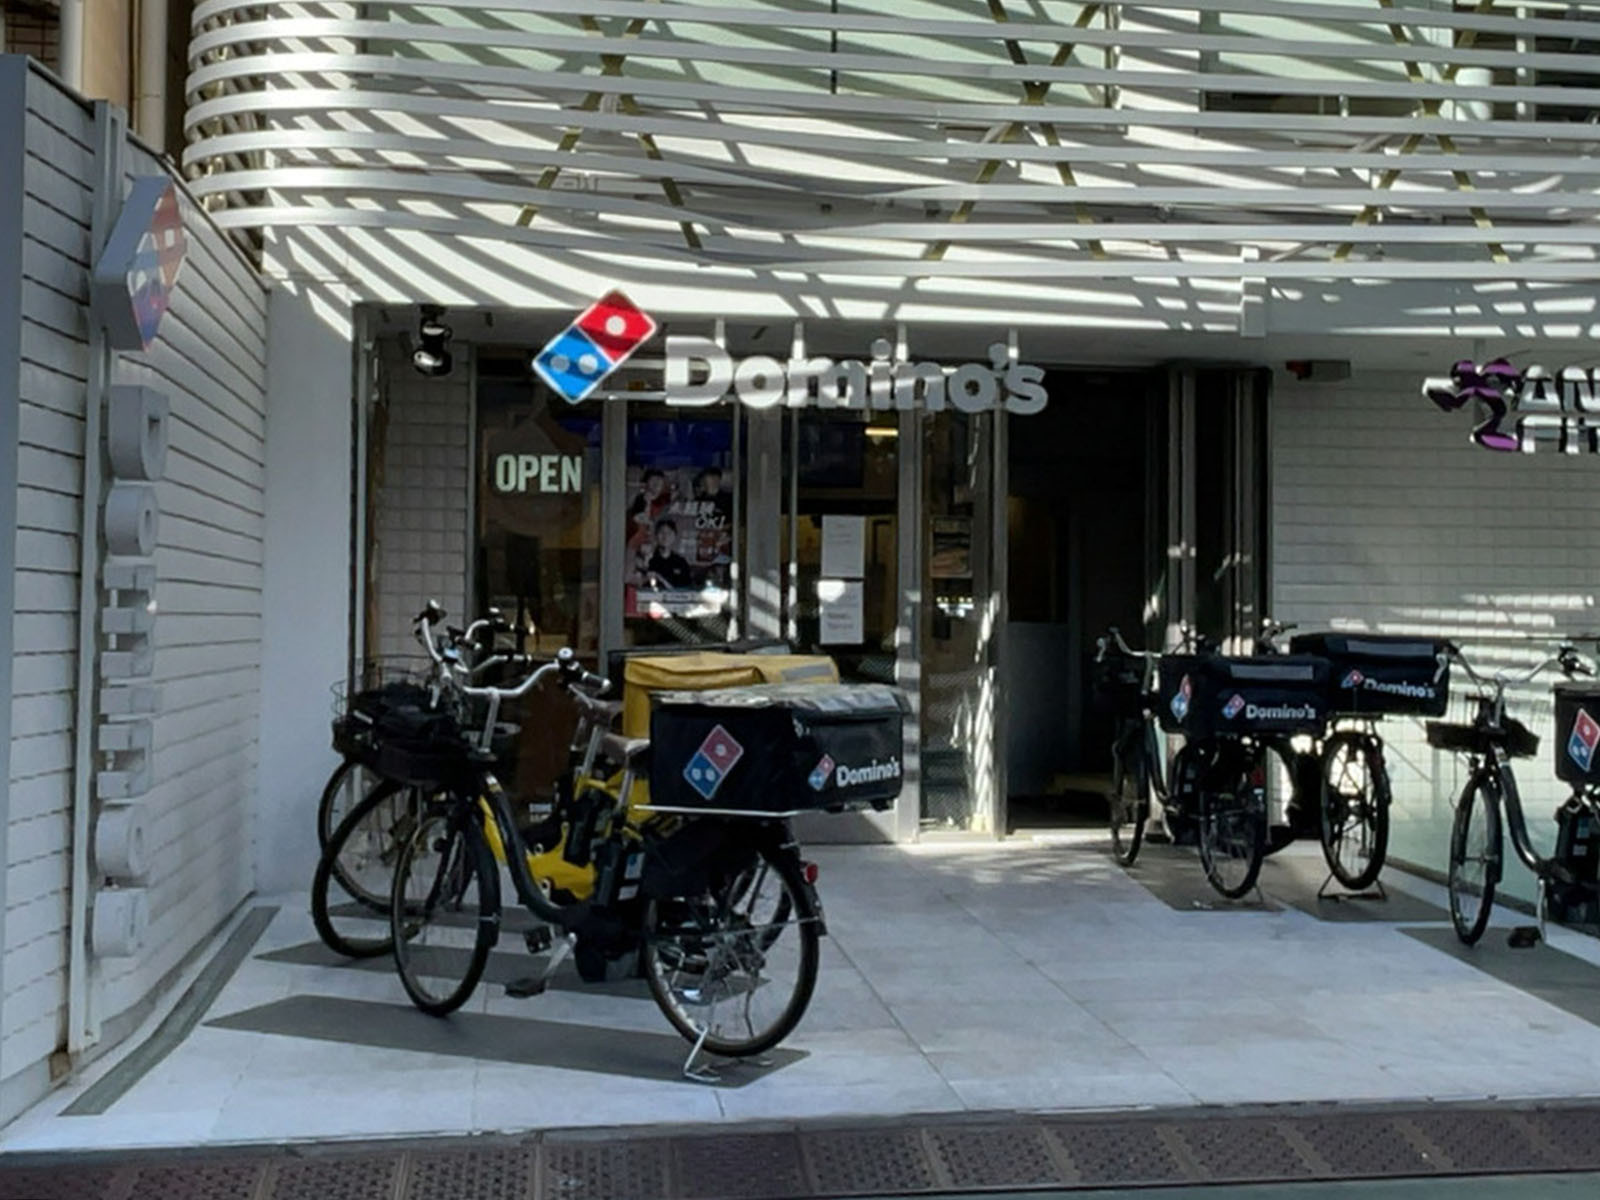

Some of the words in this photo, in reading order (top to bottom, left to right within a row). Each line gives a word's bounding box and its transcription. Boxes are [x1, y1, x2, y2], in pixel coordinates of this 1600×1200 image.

[665, 335, 1049, 415] Domino's
[496, 454, 582, 493] OPEN
[1246, 703, 1316, 720] Domino's
[836, 756, 900, 788] Domino's
